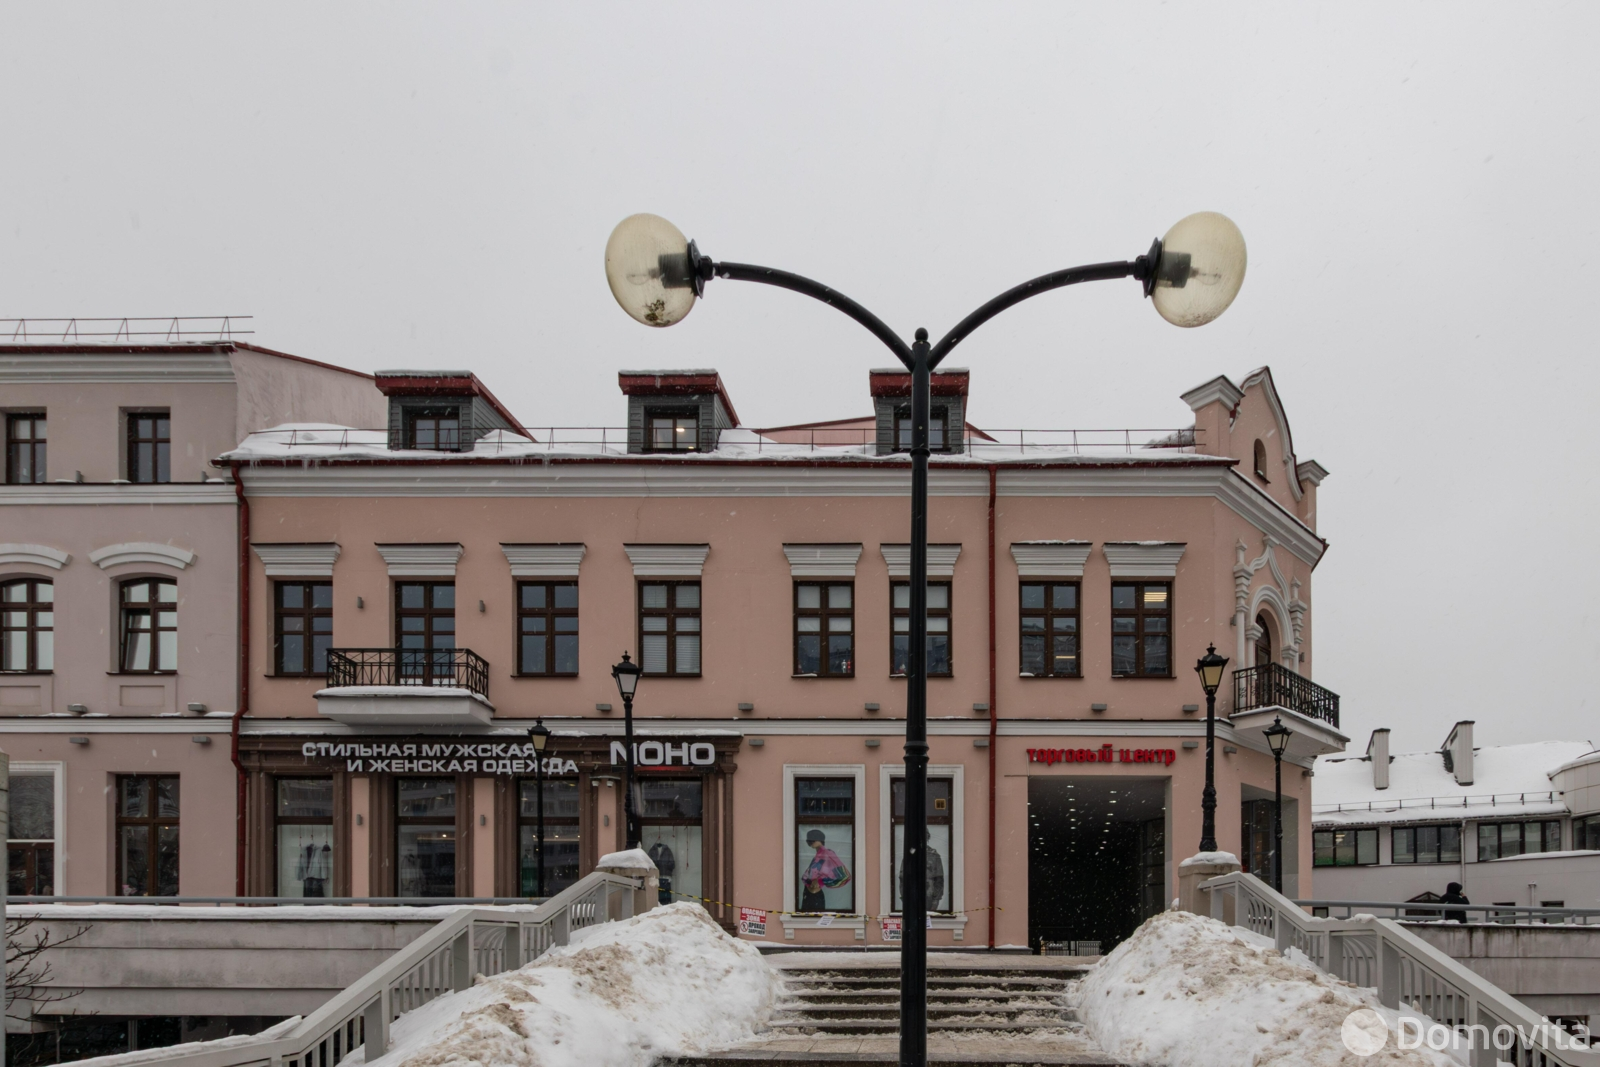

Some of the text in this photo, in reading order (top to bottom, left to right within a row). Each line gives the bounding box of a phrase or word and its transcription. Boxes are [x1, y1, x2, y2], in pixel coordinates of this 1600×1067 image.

[302, 742, 537, 757] СТИЛЬНАЯ МУЖСКАЯ
[1119, 748, 1176, 767] центр
[347, 757, 579, 775] И ЖЕНСКАЯ ОДЕЖДА
